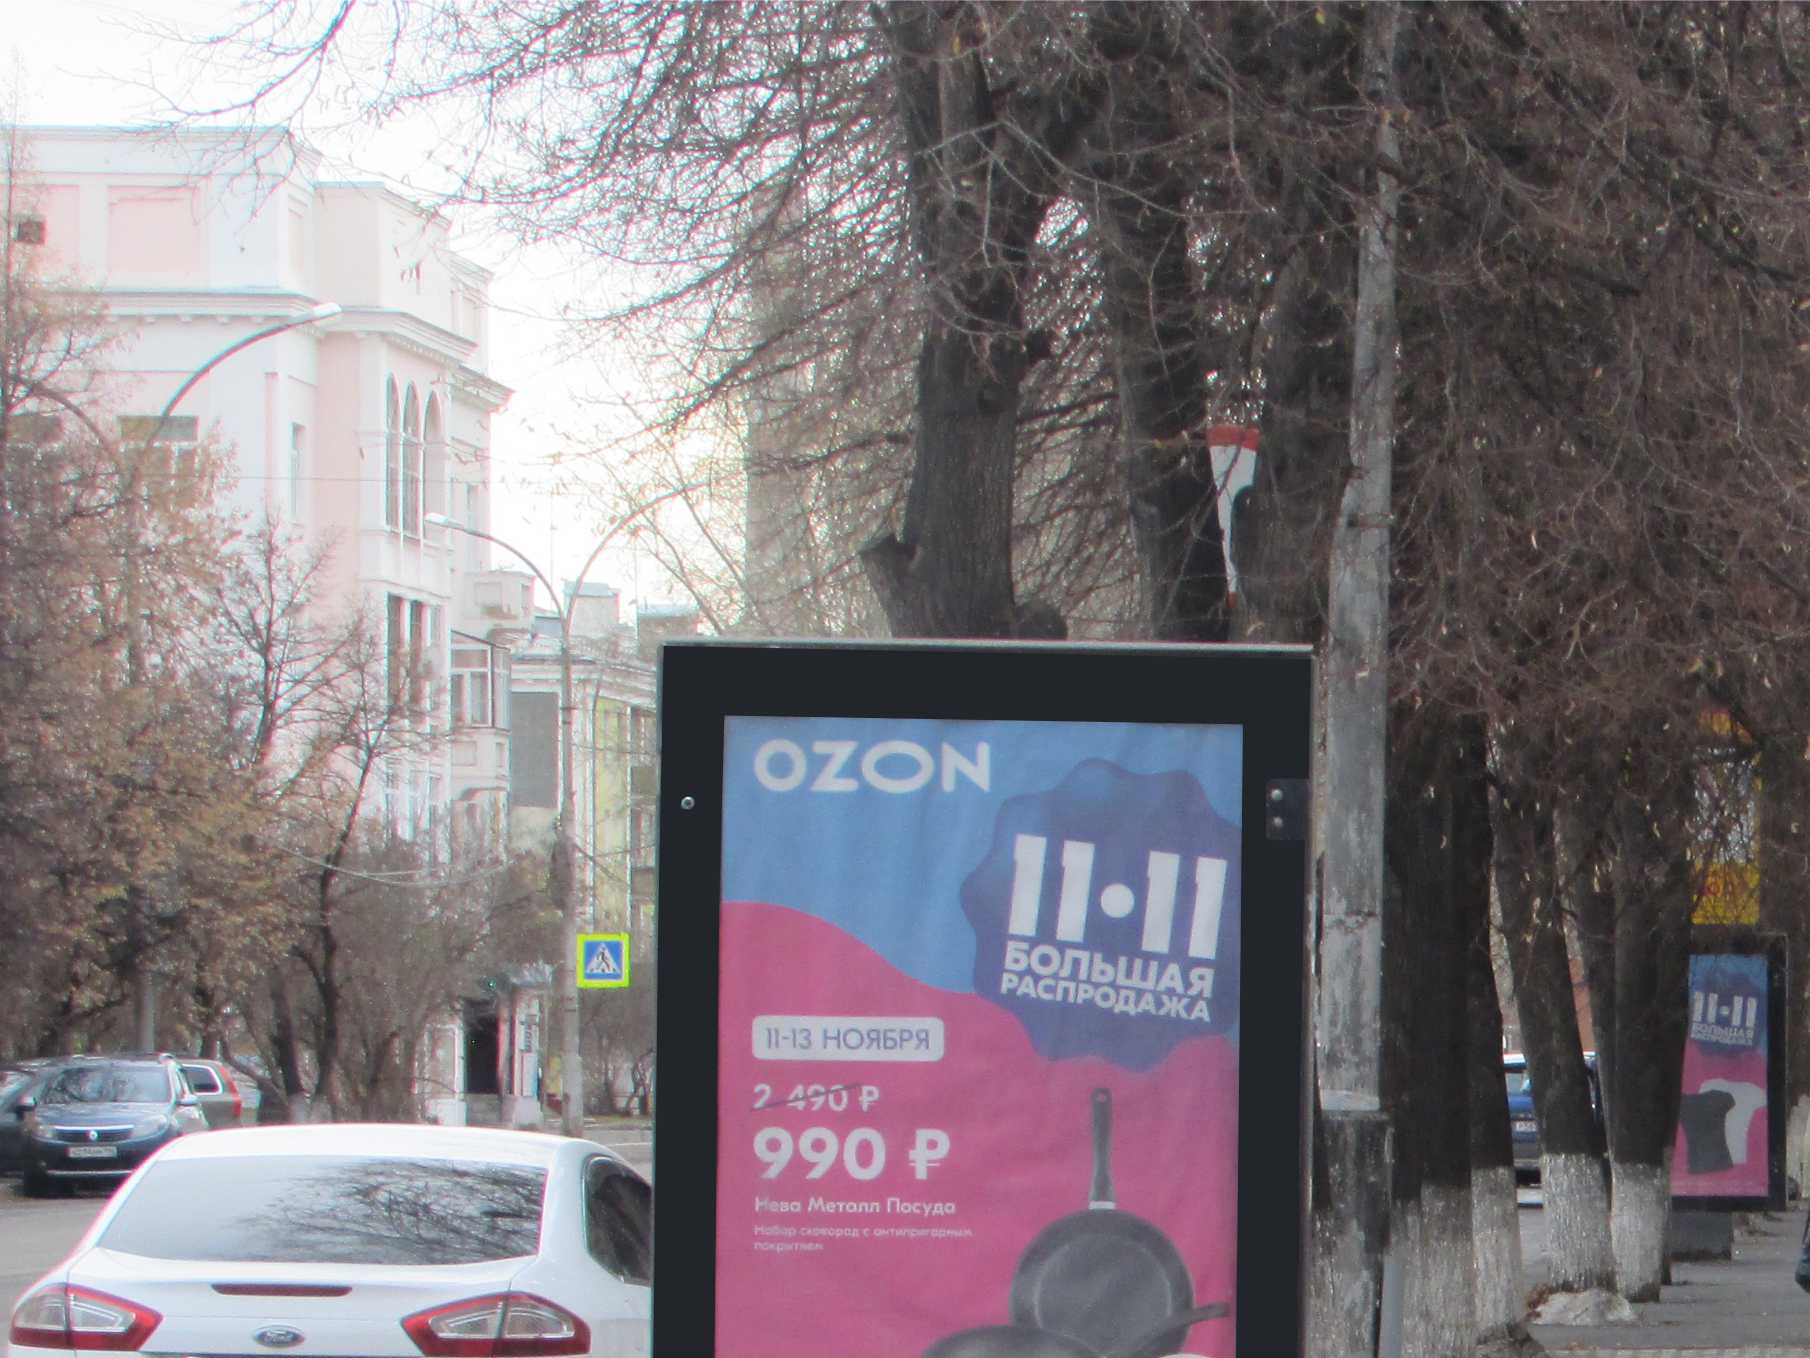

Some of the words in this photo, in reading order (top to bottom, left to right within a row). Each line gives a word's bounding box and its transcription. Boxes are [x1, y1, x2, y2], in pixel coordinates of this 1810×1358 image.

[752, 738, 991, 794] OZON
[1003, 939, 1215, 998] БОЛЬШАЯ
[1000, 971, 1212, 1023] РАСПРОДАЖА
[766, 1027, 812, 1050] 11-13
[823, 1027, 930, 1050] НОЯБРЯ
[753, 1126, 887, 1181] 990
[754, 1196, 802, 1214] Нева
[807, 1196, 881, 1214] Металл
[886, 1197, 957, 1217] Посуда
